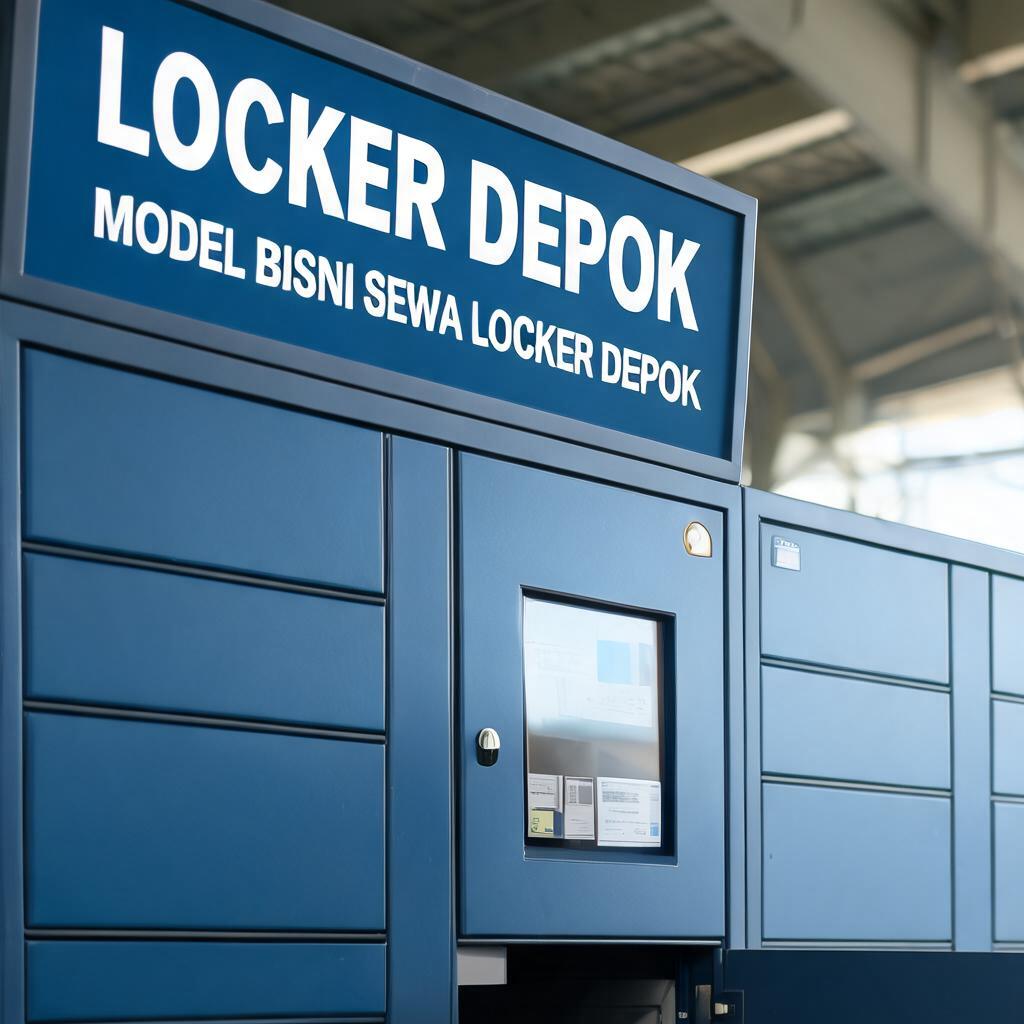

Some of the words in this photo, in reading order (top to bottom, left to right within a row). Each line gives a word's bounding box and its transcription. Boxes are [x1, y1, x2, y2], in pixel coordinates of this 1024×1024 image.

[93, 186, 246, 280] MODEL
[255, 236, 354, 310] BISNI
[363, 269, 463, 341] SEWA
[471, 300, 594, 379] LOCKER
[601, 341, 702, 411] DEPOK
[97, 25, 446, 251] LOCKER
[469, 159, 702, 332] DEPOK
